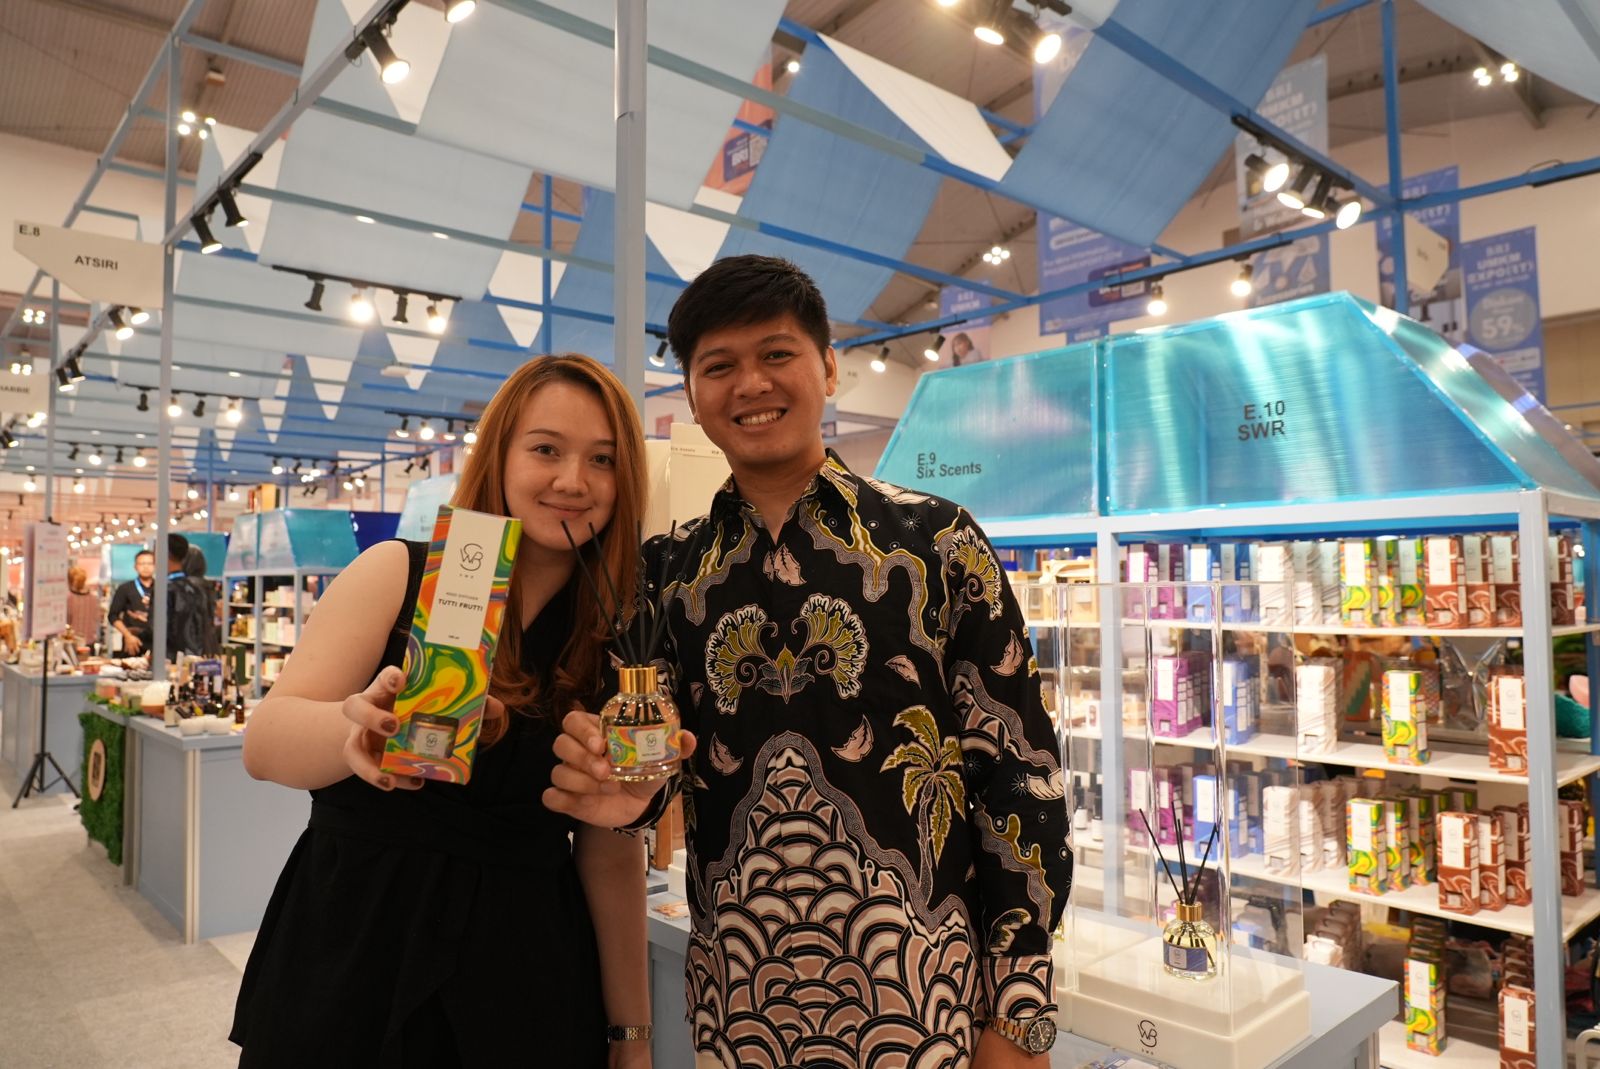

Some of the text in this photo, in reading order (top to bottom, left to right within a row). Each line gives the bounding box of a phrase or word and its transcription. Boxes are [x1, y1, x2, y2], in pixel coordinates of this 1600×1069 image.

[19, 224, 40, 237] E.8
[75, 255, 119, 271] ATSIRI
[1244, 400, 1285, 420] E.10
[1238, 420, 1285, 441] SWR
[916, 461, 982, 479] Six Scents
[438, 598, 483, 612] TUTTI FRUTTI
